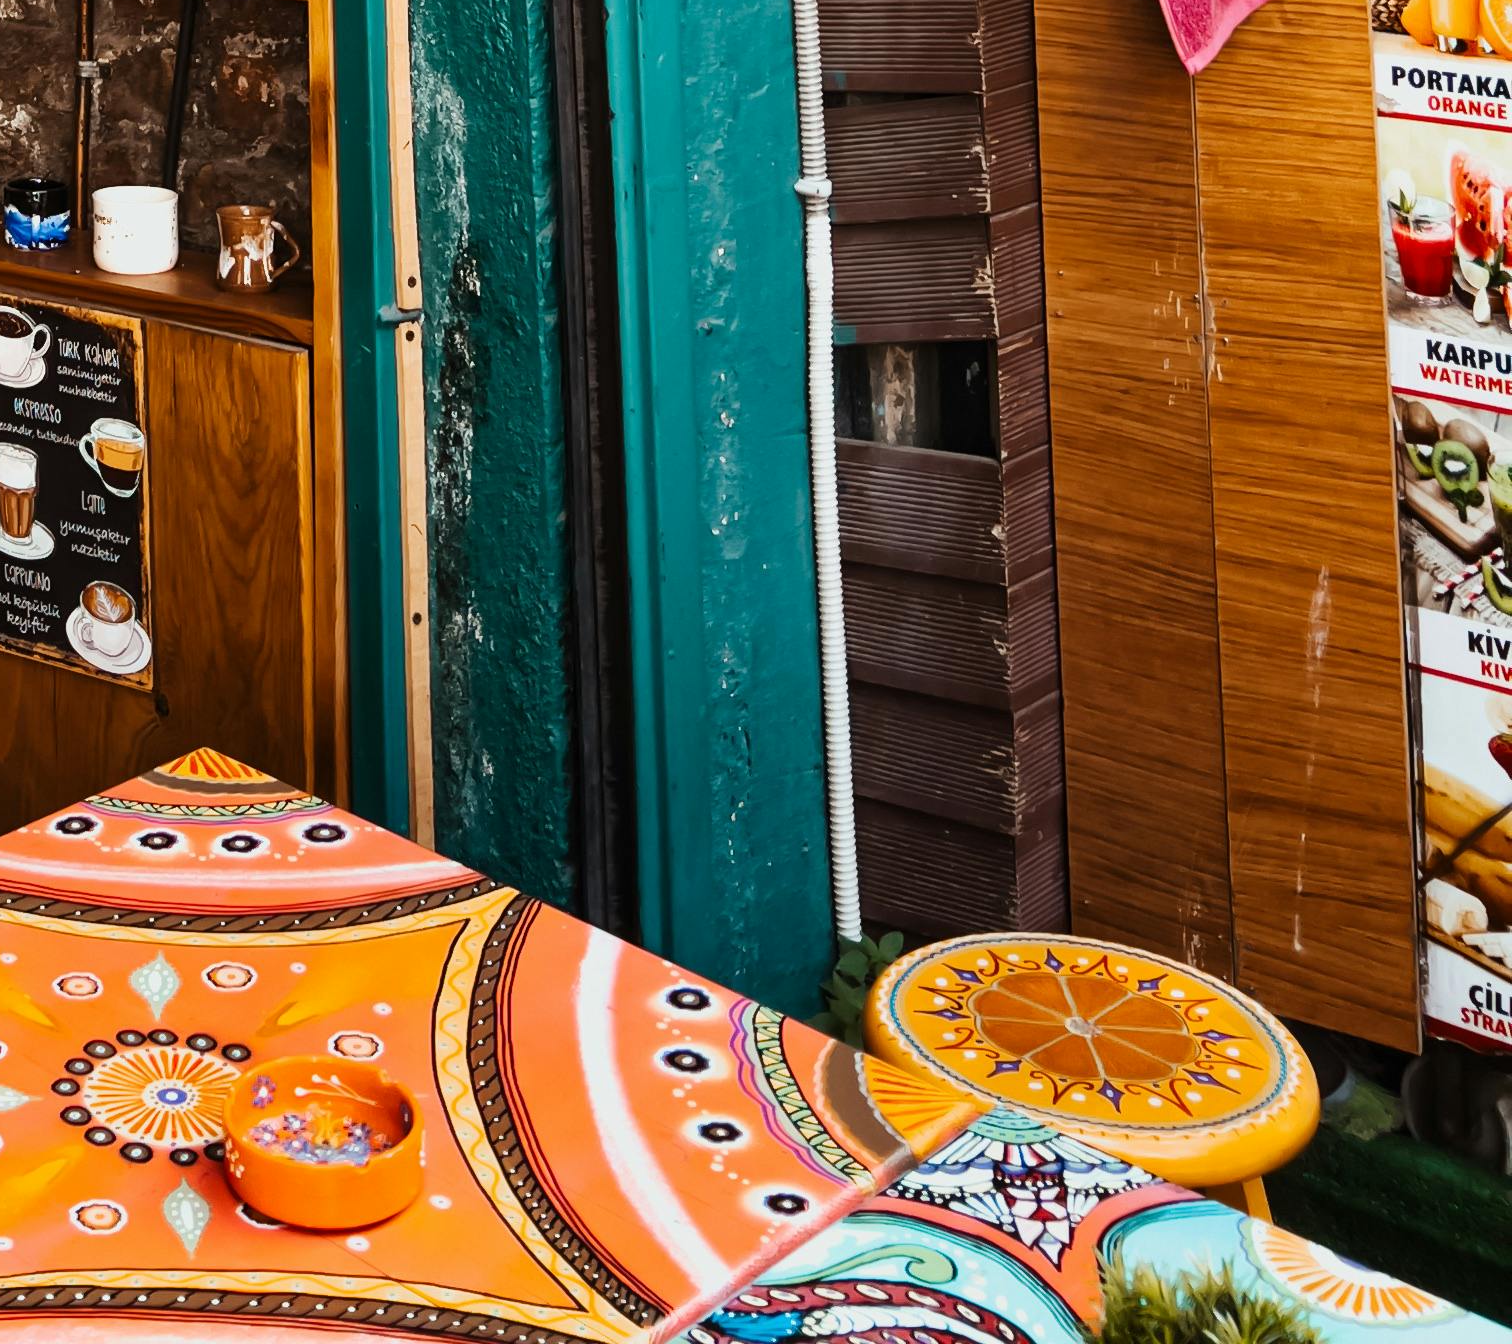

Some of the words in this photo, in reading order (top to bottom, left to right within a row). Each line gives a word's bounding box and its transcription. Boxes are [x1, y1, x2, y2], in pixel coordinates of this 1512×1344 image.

[1391, 65, 1512, 100] PORTAKA
[1428, 95, 1508, 120] ORANGE
[71, 543, 121, 564] naziktir
[1468, 982, 1512, 1017] ÇİL
